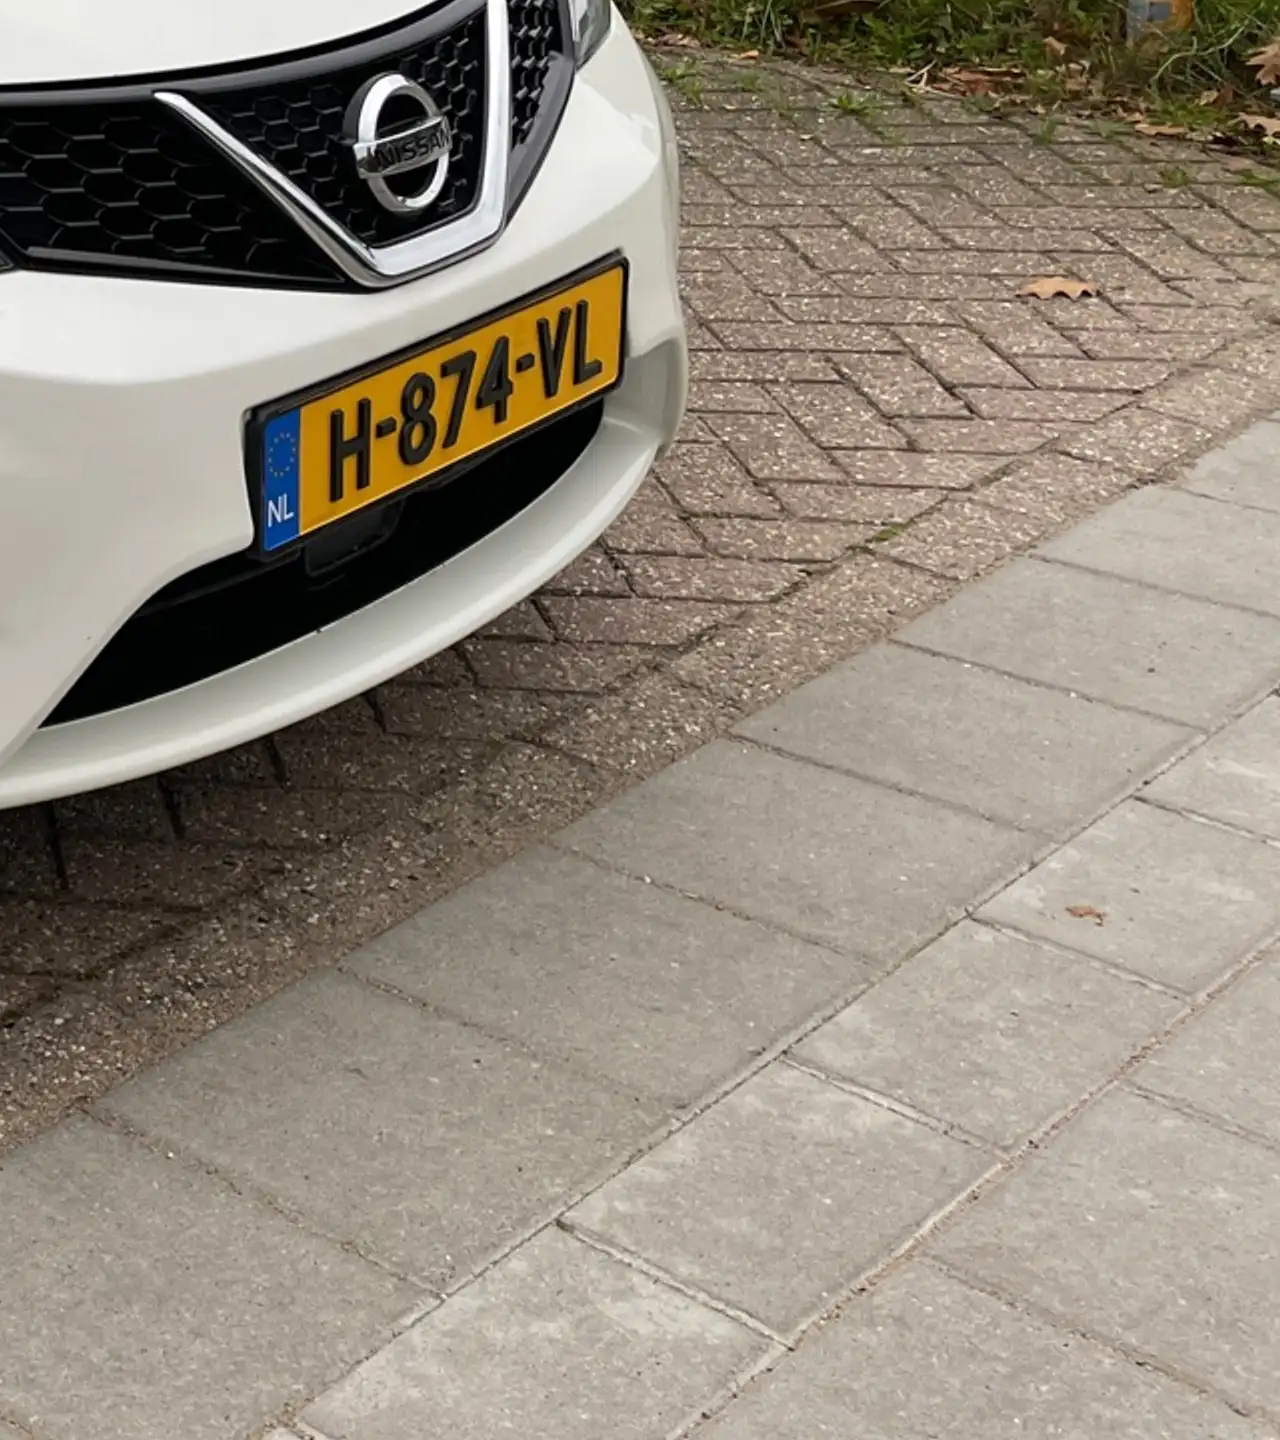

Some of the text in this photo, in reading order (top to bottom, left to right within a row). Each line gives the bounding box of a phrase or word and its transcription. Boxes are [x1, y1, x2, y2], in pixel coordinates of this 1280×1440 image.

[376, 127, 452, 165] NISSAN
[329, 299, 603, 503] H-874-VL
[267, 493, 294, 528] NL
